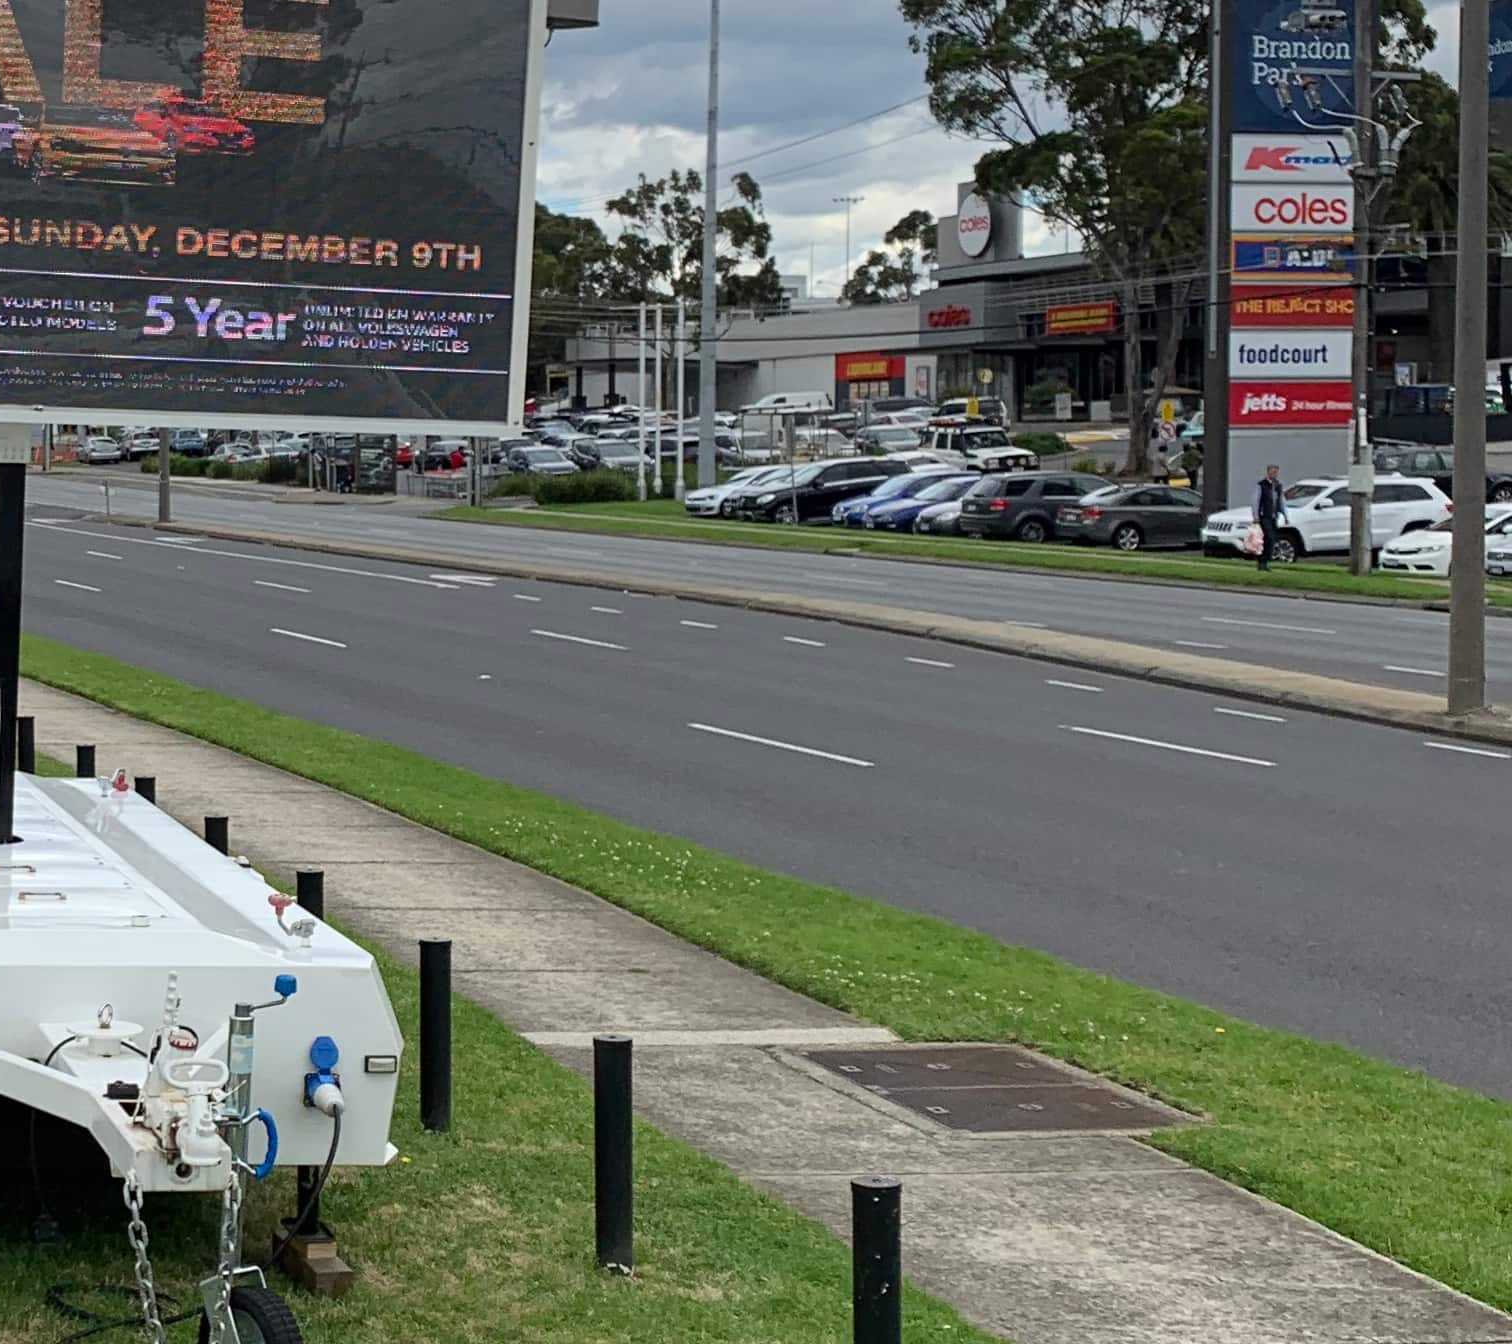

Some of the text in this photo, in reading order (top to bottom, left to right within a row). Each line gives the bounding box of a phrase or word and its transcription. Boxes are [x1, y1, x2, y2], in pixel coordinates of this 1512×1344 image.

[1252, 34, 1352, 60] Brandon
[1254, 192, 1348, 225] coles
[959, 215, 989, 233] coles
[176, 225, 399, 267] DECEMBER
[412, 240, 482, 272] 9TH
[143, 295, 297, 341] 5 Year
[928, 304, 970, 328] coles
[1235, 299, 1264, 313] THE
[1324, 299, 1354, 314] SHO
[1238, 343, 1328, 365] foodcourt
[1241, 392, 1288, 415] jetts
